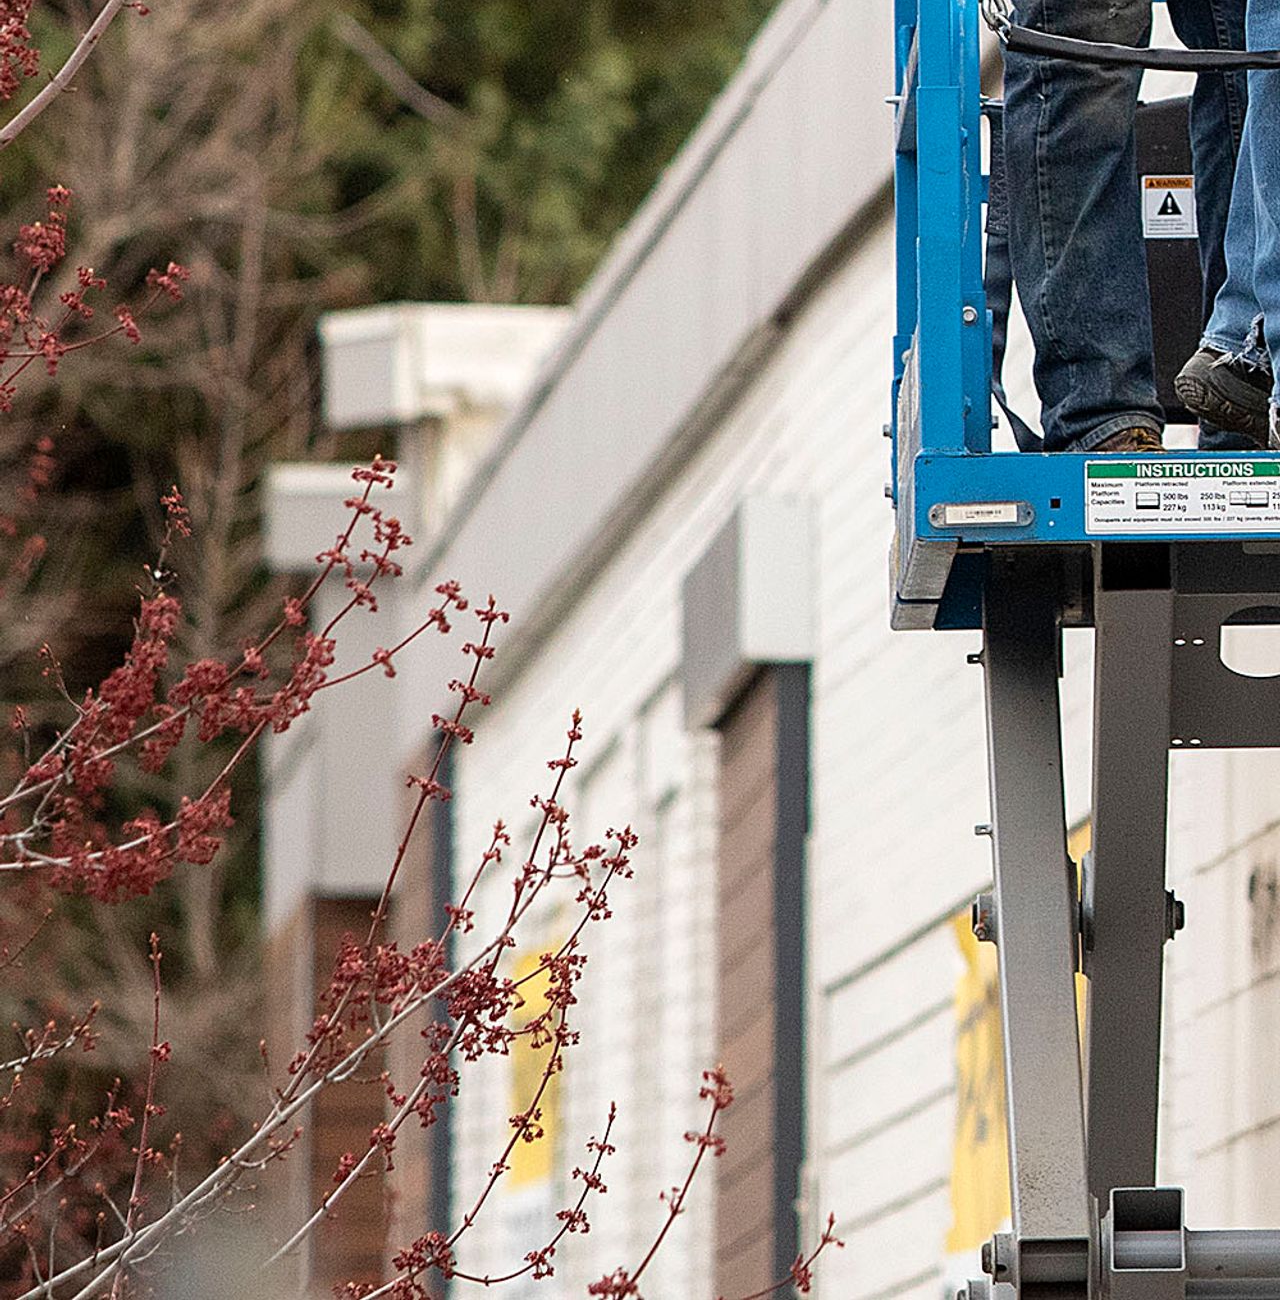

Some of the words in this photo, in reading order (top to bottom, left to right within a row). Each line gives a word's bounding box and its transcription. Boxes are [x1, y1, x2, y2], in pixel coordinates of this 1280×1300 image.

[1136, 463, 1254, 477] INSTRUCTIONS
[1200, 492, 1213, 500] 250
[1214, 492, 1226, 500] lbs
[1090, 498, 1125, 506] Capacities
[1163, 504, 1176, 512] 227
[1178, 504, 1186, 512] kg
[1217, 504, 1226, 512] kg
